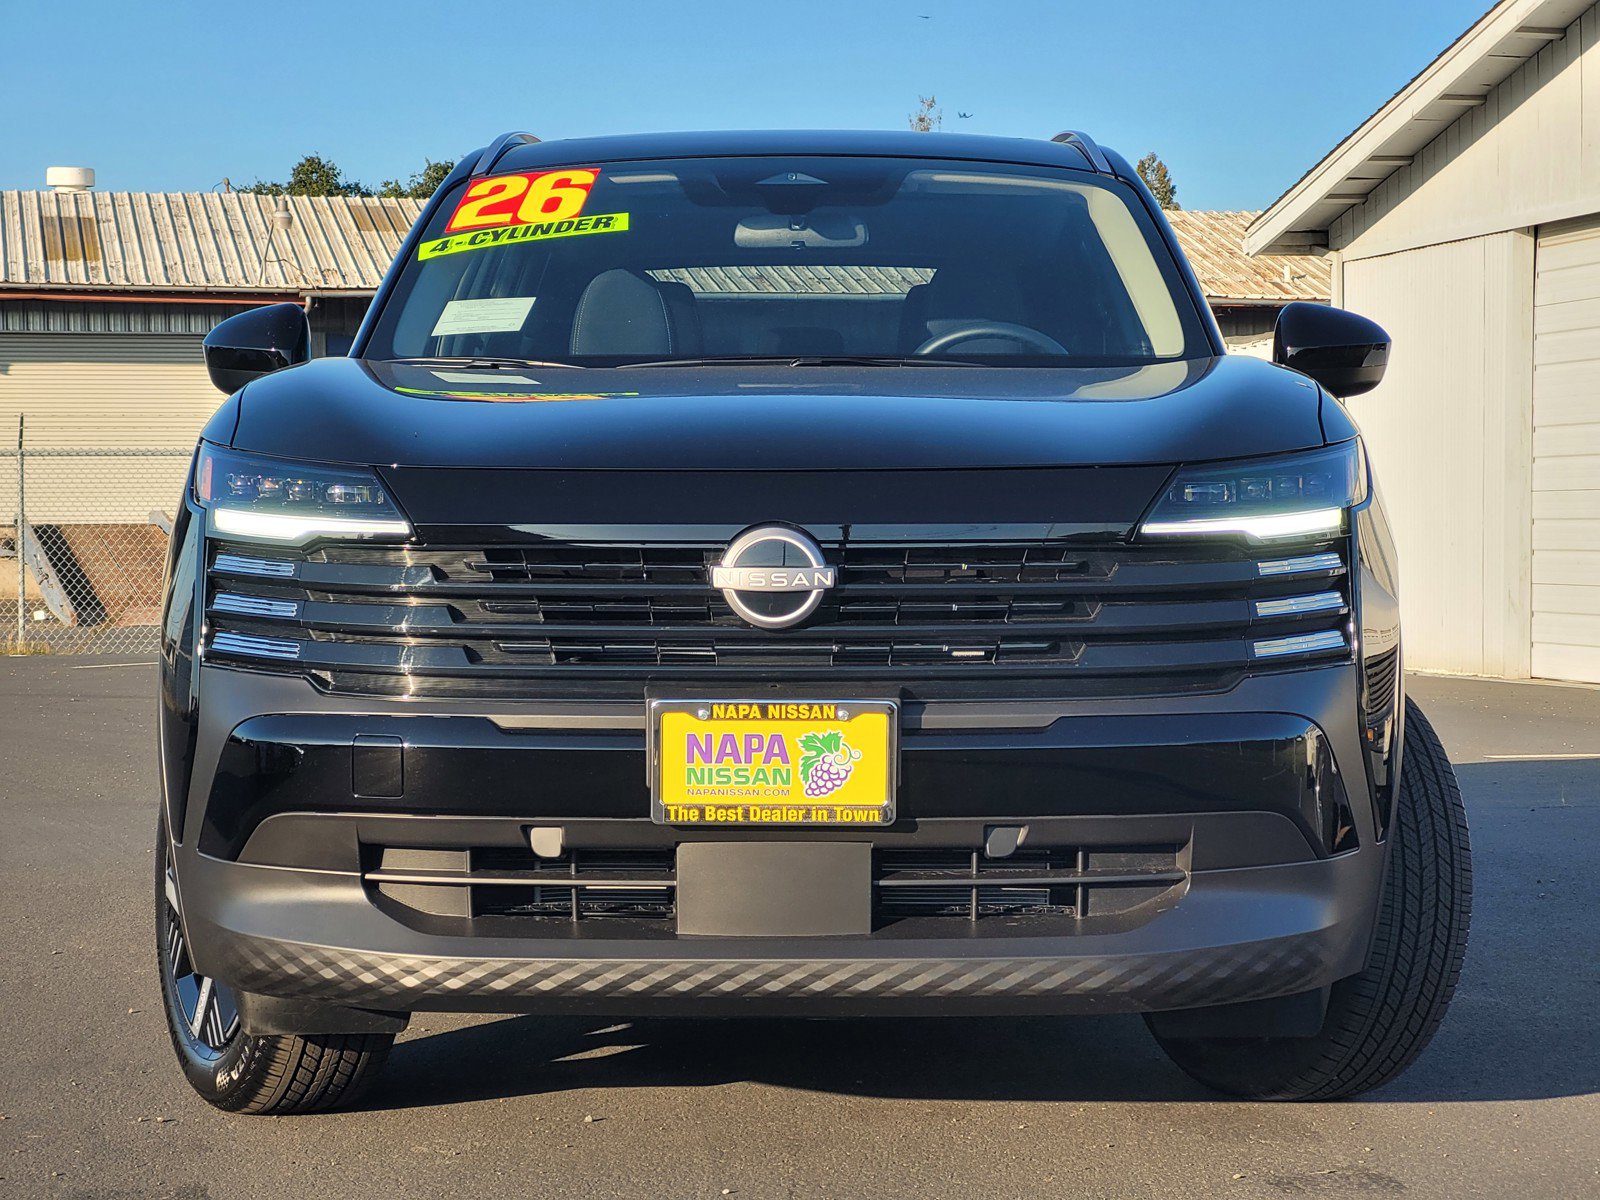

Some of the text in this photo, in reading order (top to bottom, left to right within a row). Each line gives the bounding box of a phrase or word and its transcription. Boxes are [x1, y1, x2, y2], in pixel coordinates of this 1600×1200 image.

[450, 169, 595, 229] 26
[429, 216, 618, 253] 4-CYLINDER
[716, 571, 832, 587] NISSAN
[712, 704, 835, 719] NAPA NISSAN
[686, 733, 790, 764] NAPA
[686, 767, 791, 786] NISSAN
[687, 788, 790, 797] NAPANISSAN.COM
[667, 806, 881, 822] The Best Dealer in Town
